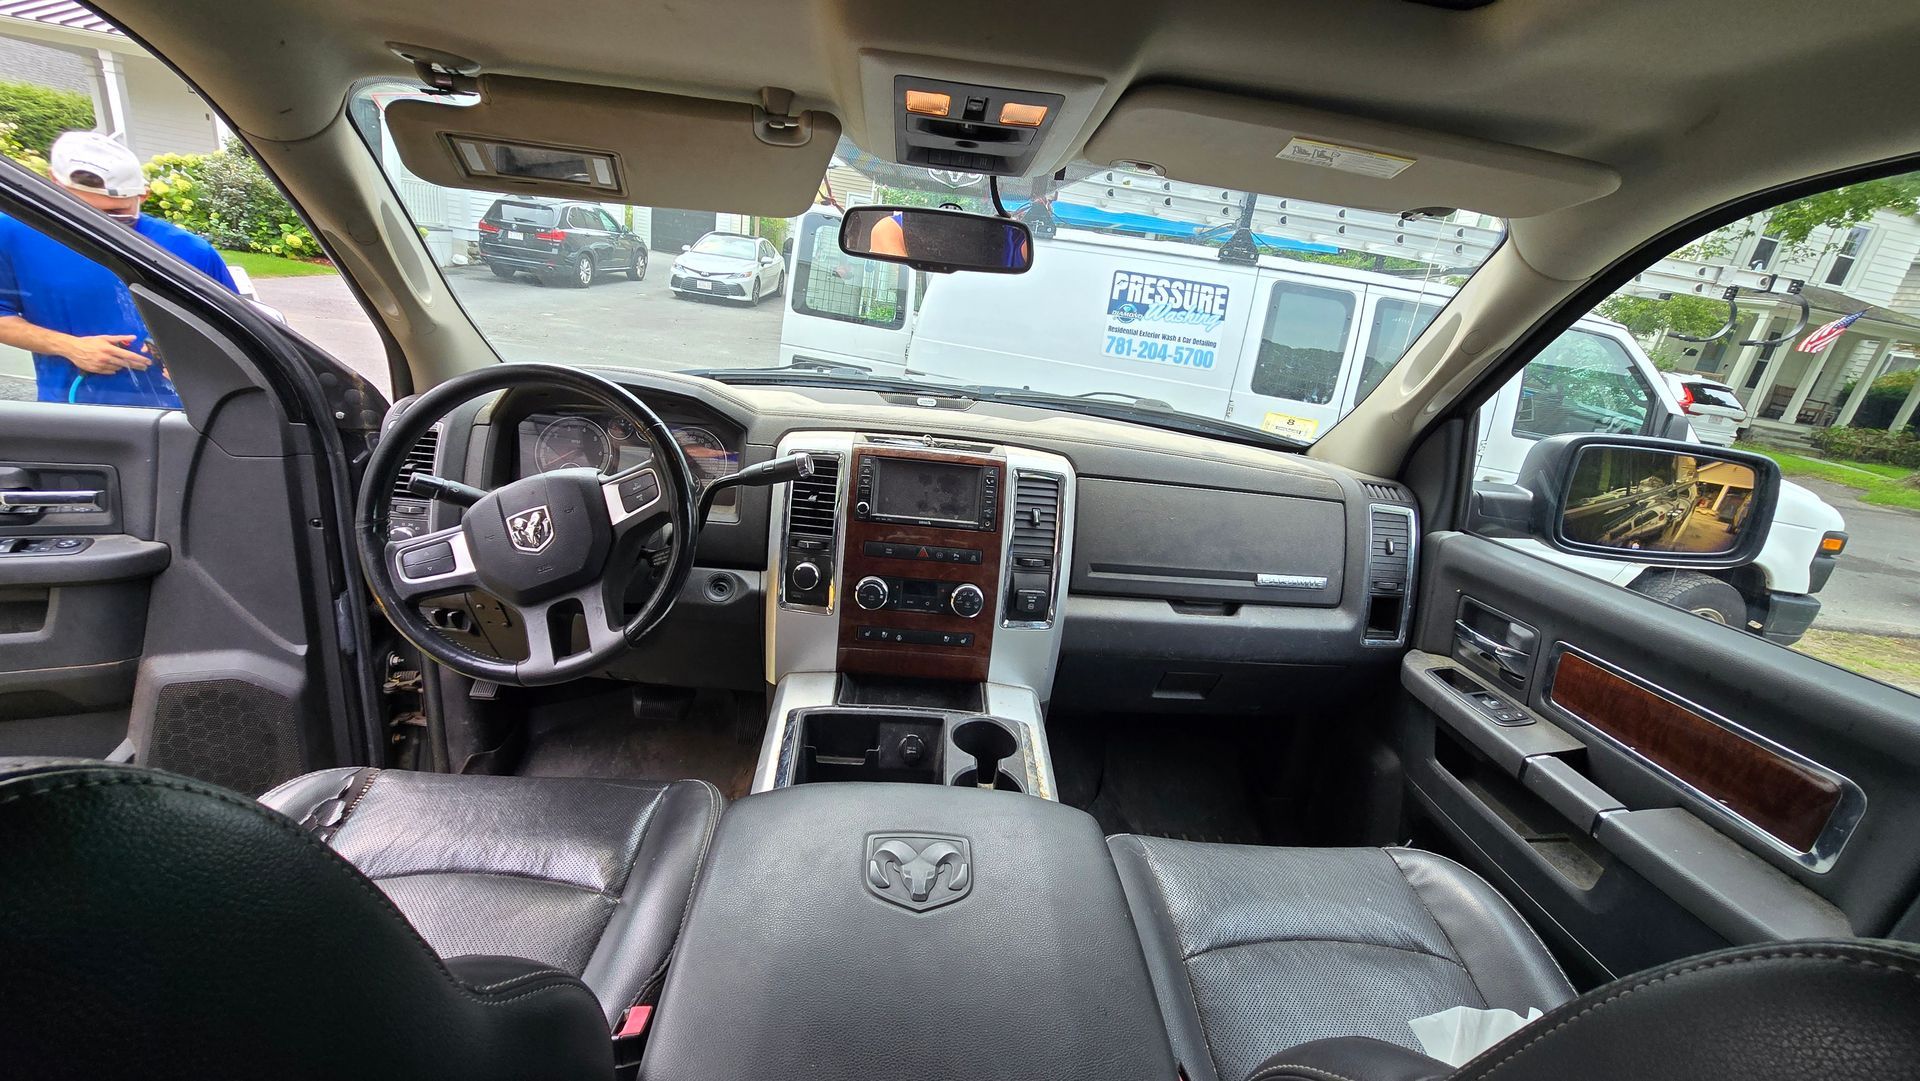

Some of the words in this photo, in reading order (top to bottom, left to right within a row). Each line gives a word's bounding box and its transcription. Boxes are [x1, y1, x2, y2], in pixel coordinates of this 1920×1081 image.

[1112, 272, 1227, 316] PRESSURE
[1111, 309, 1143, 321] DIAMOND
[1144, 302, 1222, 332] Washing
[1108, 325, 1138, 336] Residential
[1139, 330, 1160, 339] Exterior
[1161, 333, 1176, 342] Wash
[1192, 338, 1217, 348] Detailing
[1105, 335, 1214, 369] 781-204-5700
